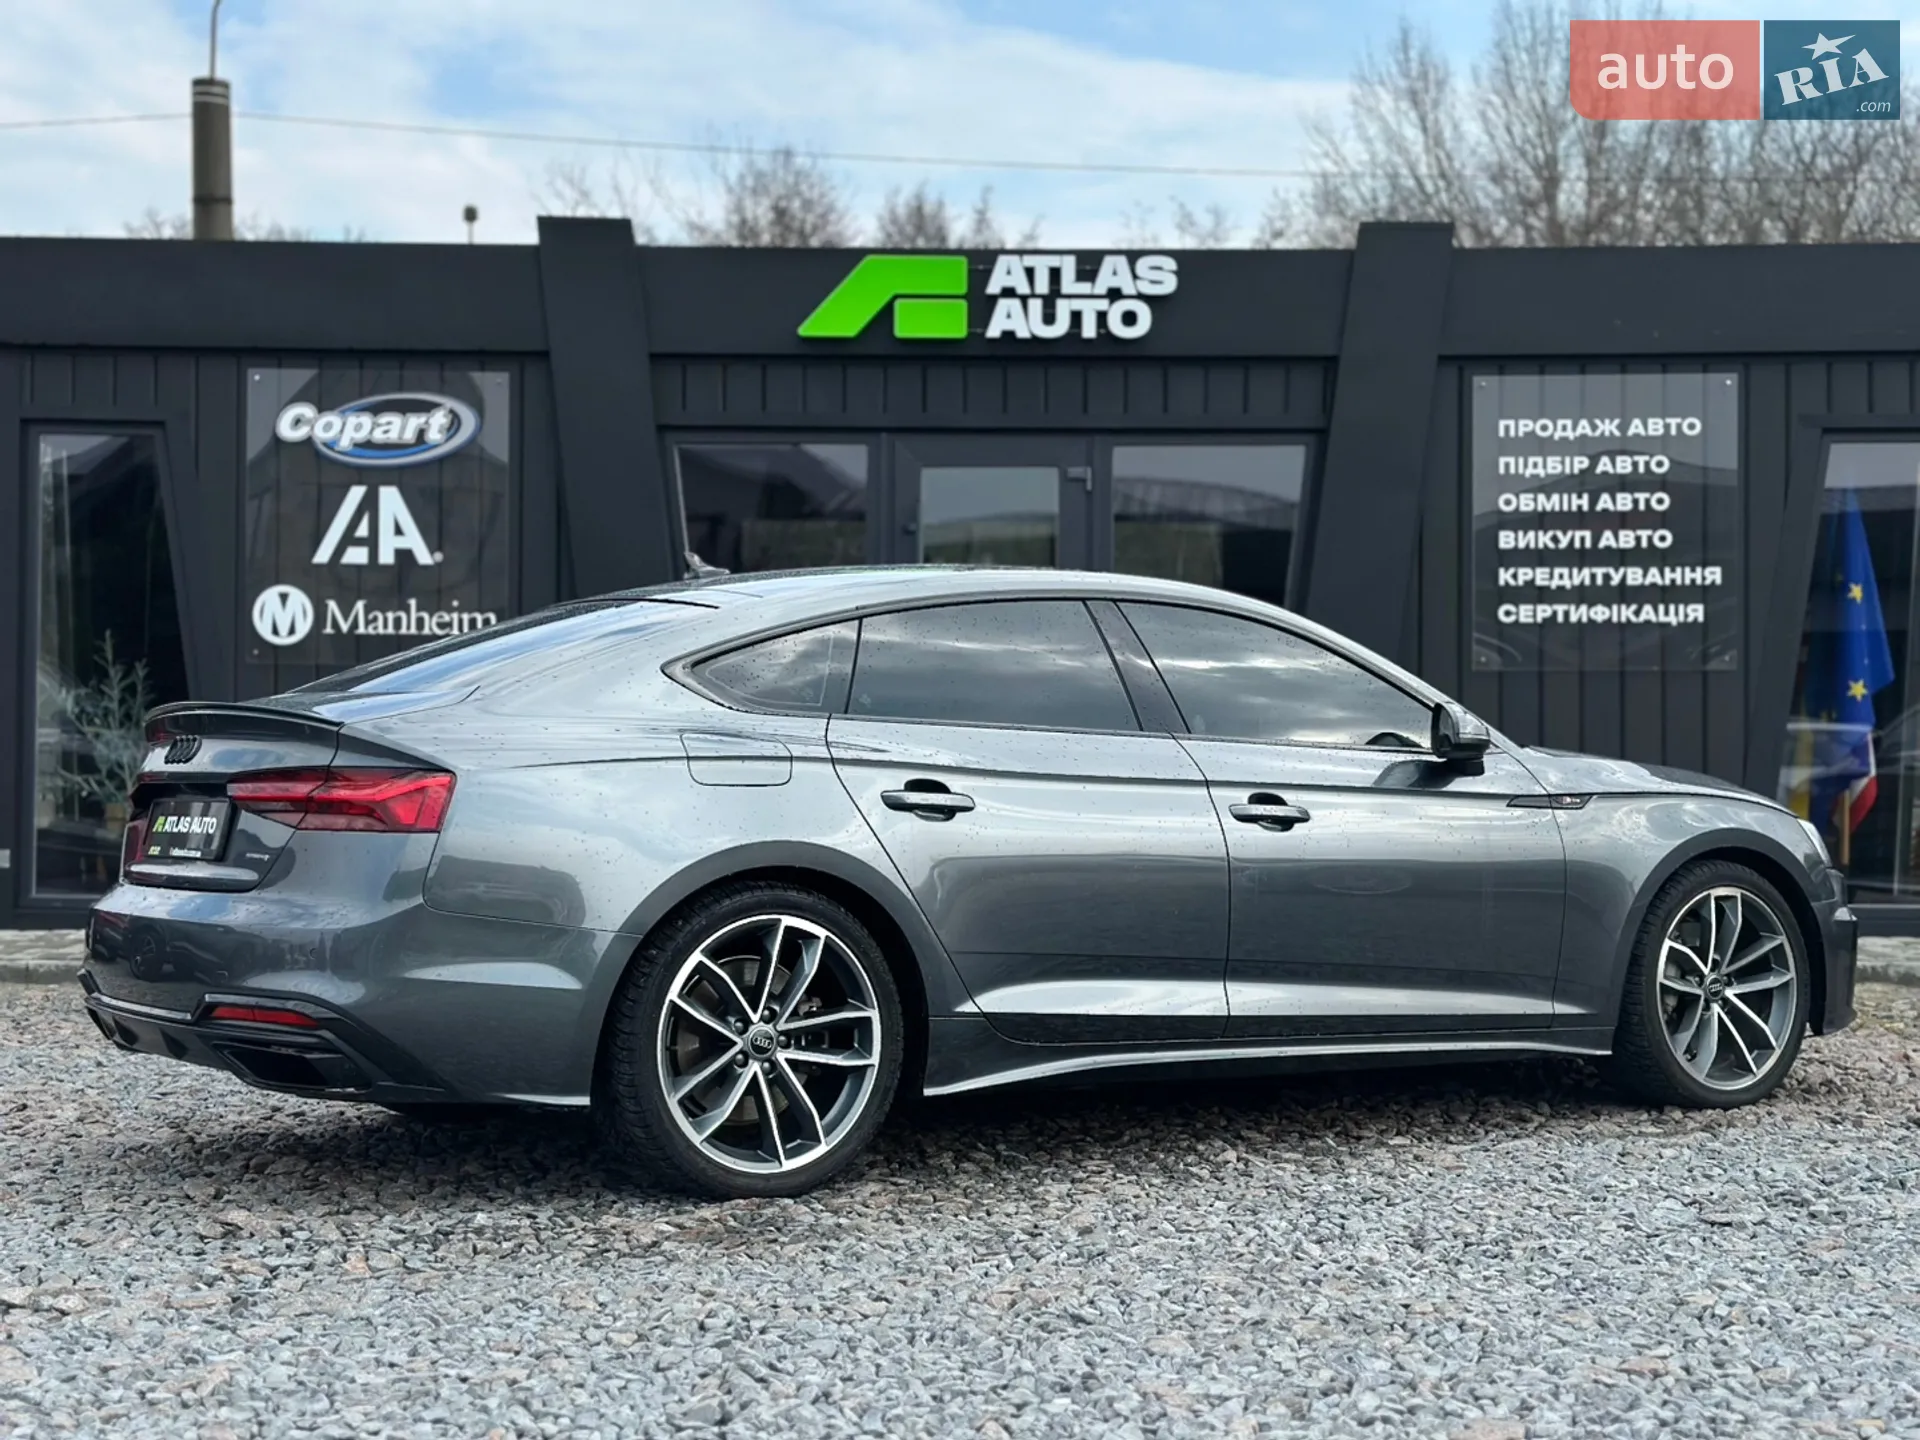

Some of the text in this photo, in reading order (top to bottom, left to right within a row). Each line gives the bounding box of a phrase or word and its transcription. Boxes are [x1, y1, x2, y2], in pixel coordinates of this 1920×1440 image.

[985, 254, 1178, 296] ATLAS
[985, 298, 1152, 339] AUTO
[275, 402, 450, 449] Copart
[1498, 417, 1702, 441] ПРОДАЖ АВТО
[1498, 455, 1670, 478] ПІДБІР АВТО
[1497, 492, 1671, 512] ОБМІН АВТО
[1498, 529, 1673, 549] ВИКУП АВТО
[1498, 566, 1722, 590] КРЕДИТУВАННЯ
[323, 598, 498, 635] Manheim
[1497, 603, 1705, 627] СЕРТИФІКАЦІЯ
[164, 816, 217, 834] ATLAS AUTO
